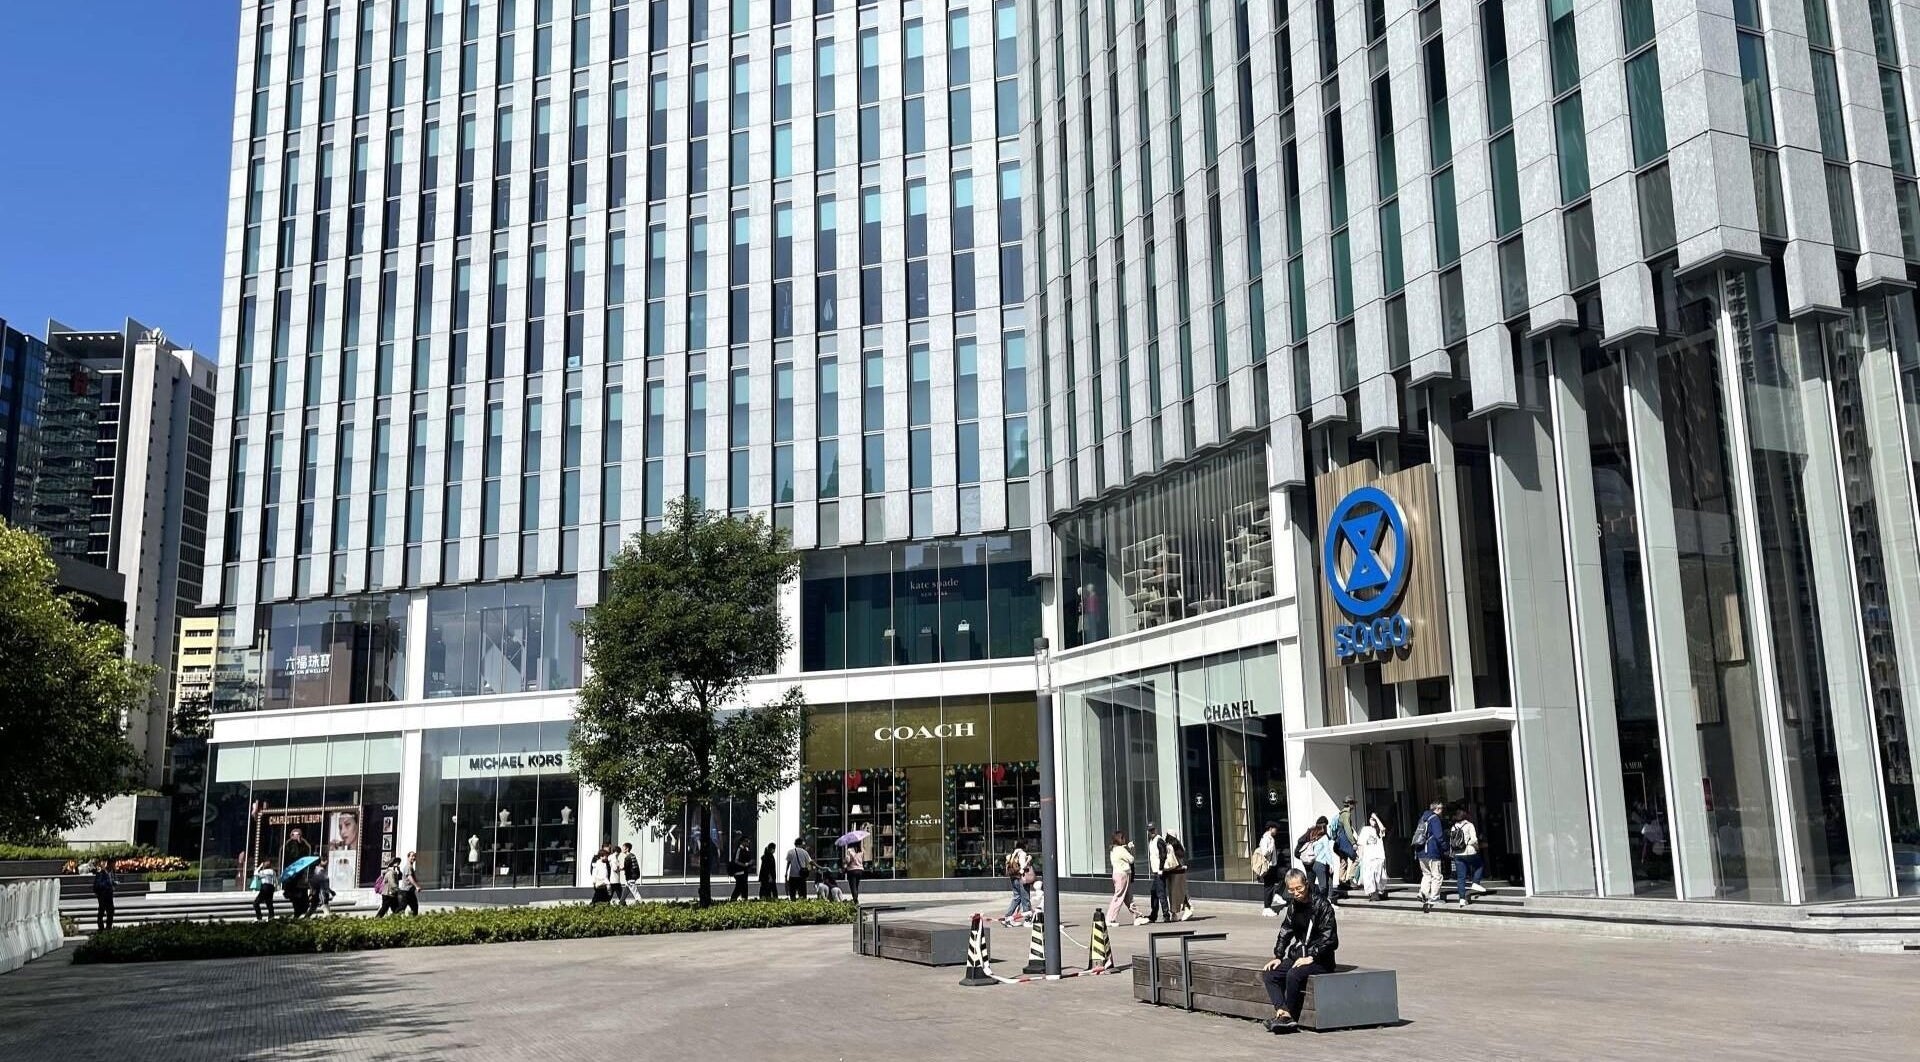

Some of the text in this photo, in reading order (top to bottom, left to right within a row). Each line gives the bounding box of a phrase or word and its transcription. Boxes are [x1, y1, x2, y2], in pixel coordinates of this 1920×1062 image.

[910, 578, 959, 591] kate spade
[1334, 613, 1411, 657] SOGO
[1203, 700, 1259, 720] CHANEL
[874, 723, 976, 741] COACH
[469, 754, 563, 771] MICHAEL KORS
